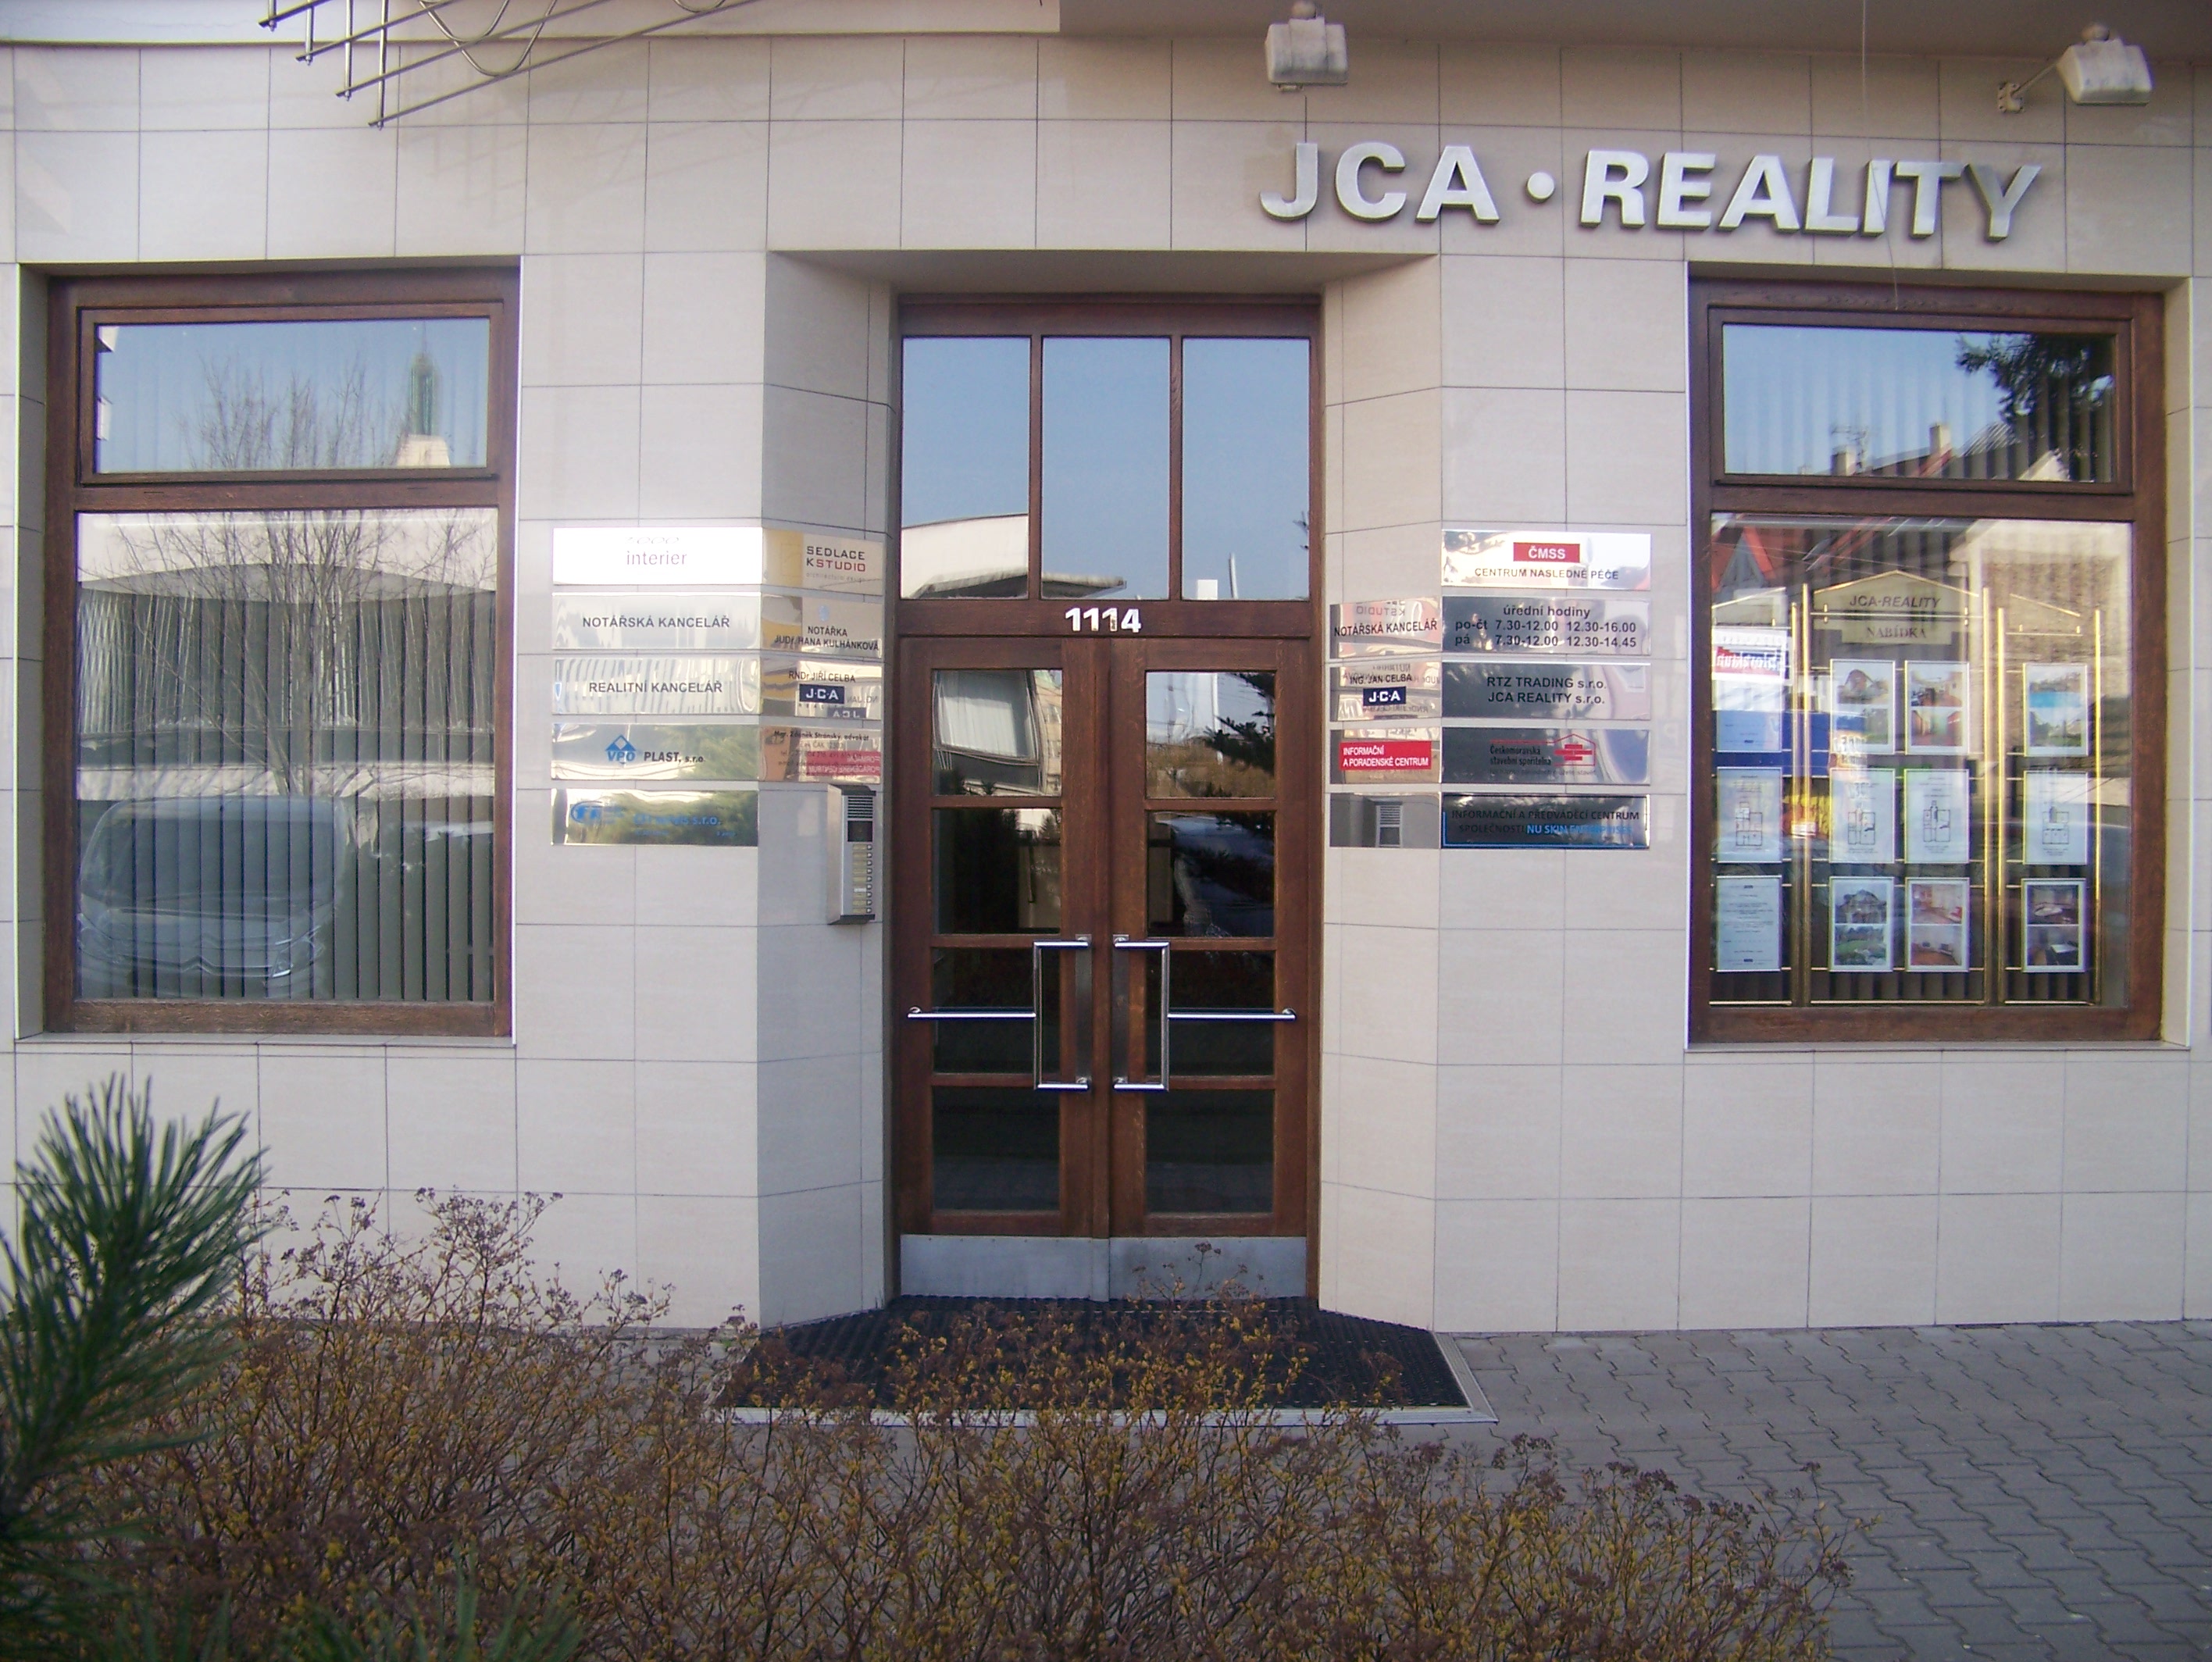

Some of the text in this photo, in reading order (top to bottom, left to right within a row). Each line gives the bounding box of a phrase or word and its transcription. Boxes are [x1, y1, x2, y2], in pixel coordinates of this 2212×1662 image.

[1259, 141, 2042, 241] JCA REALITY
[626, 550, 687, 565] interier
[807, 546, 865, 560] SEDLACE
[1528, 546, 1566, 559] ČMSS
[807, 558, 865, 572] KSTUDIO
[1475, 568, 1527, 577] CENTRUM
[1850, 595, 1940, 608] JCA-REALITY
[1503, 605, 1590, 619] úřední hodiny
[583, 615, 730, 628] NOTÁŘSKÁ KANCELÁŘ
[1065, 608, 1141, 633] 1114
[1455, 619, 1636, 633] po-čt 7.30-12.00 12.30-16.00
[808, 626, 847, 637] NOTÁŘKA
[1334, 618, 1437, 637] NOTÁŘSKÁ KANCELÁŘ
[1454, 634, 1636, 647] pá 7.30-12.00 12.30-14.45
[829, 673, 856, 683] CELBA
[1385, 673, 1412, 683] CELBA
[1487, 677, 1607, 689] RTZ TRADING s.r.o.
[589, 681, 722, 693] REALITNÍ KANCELÁŘ
[1488, 692, 1604, 704] JCA REALITY s.r.o.
[1343, 745, 1384, 755] INFORMAČNÍ
[607, 751, 636, 762] VPO
[1395, 757, 1429, 767] CENTRUM
[1451, 808, 1516, 819] INFORMAČNÍ
[1518, 810, 1525, 819] A
[1591, 810, 1639, 820] CENTRUM
[1527, 824, 1542, 833] NU
[1544, 824, 1567, 834] SKIN
